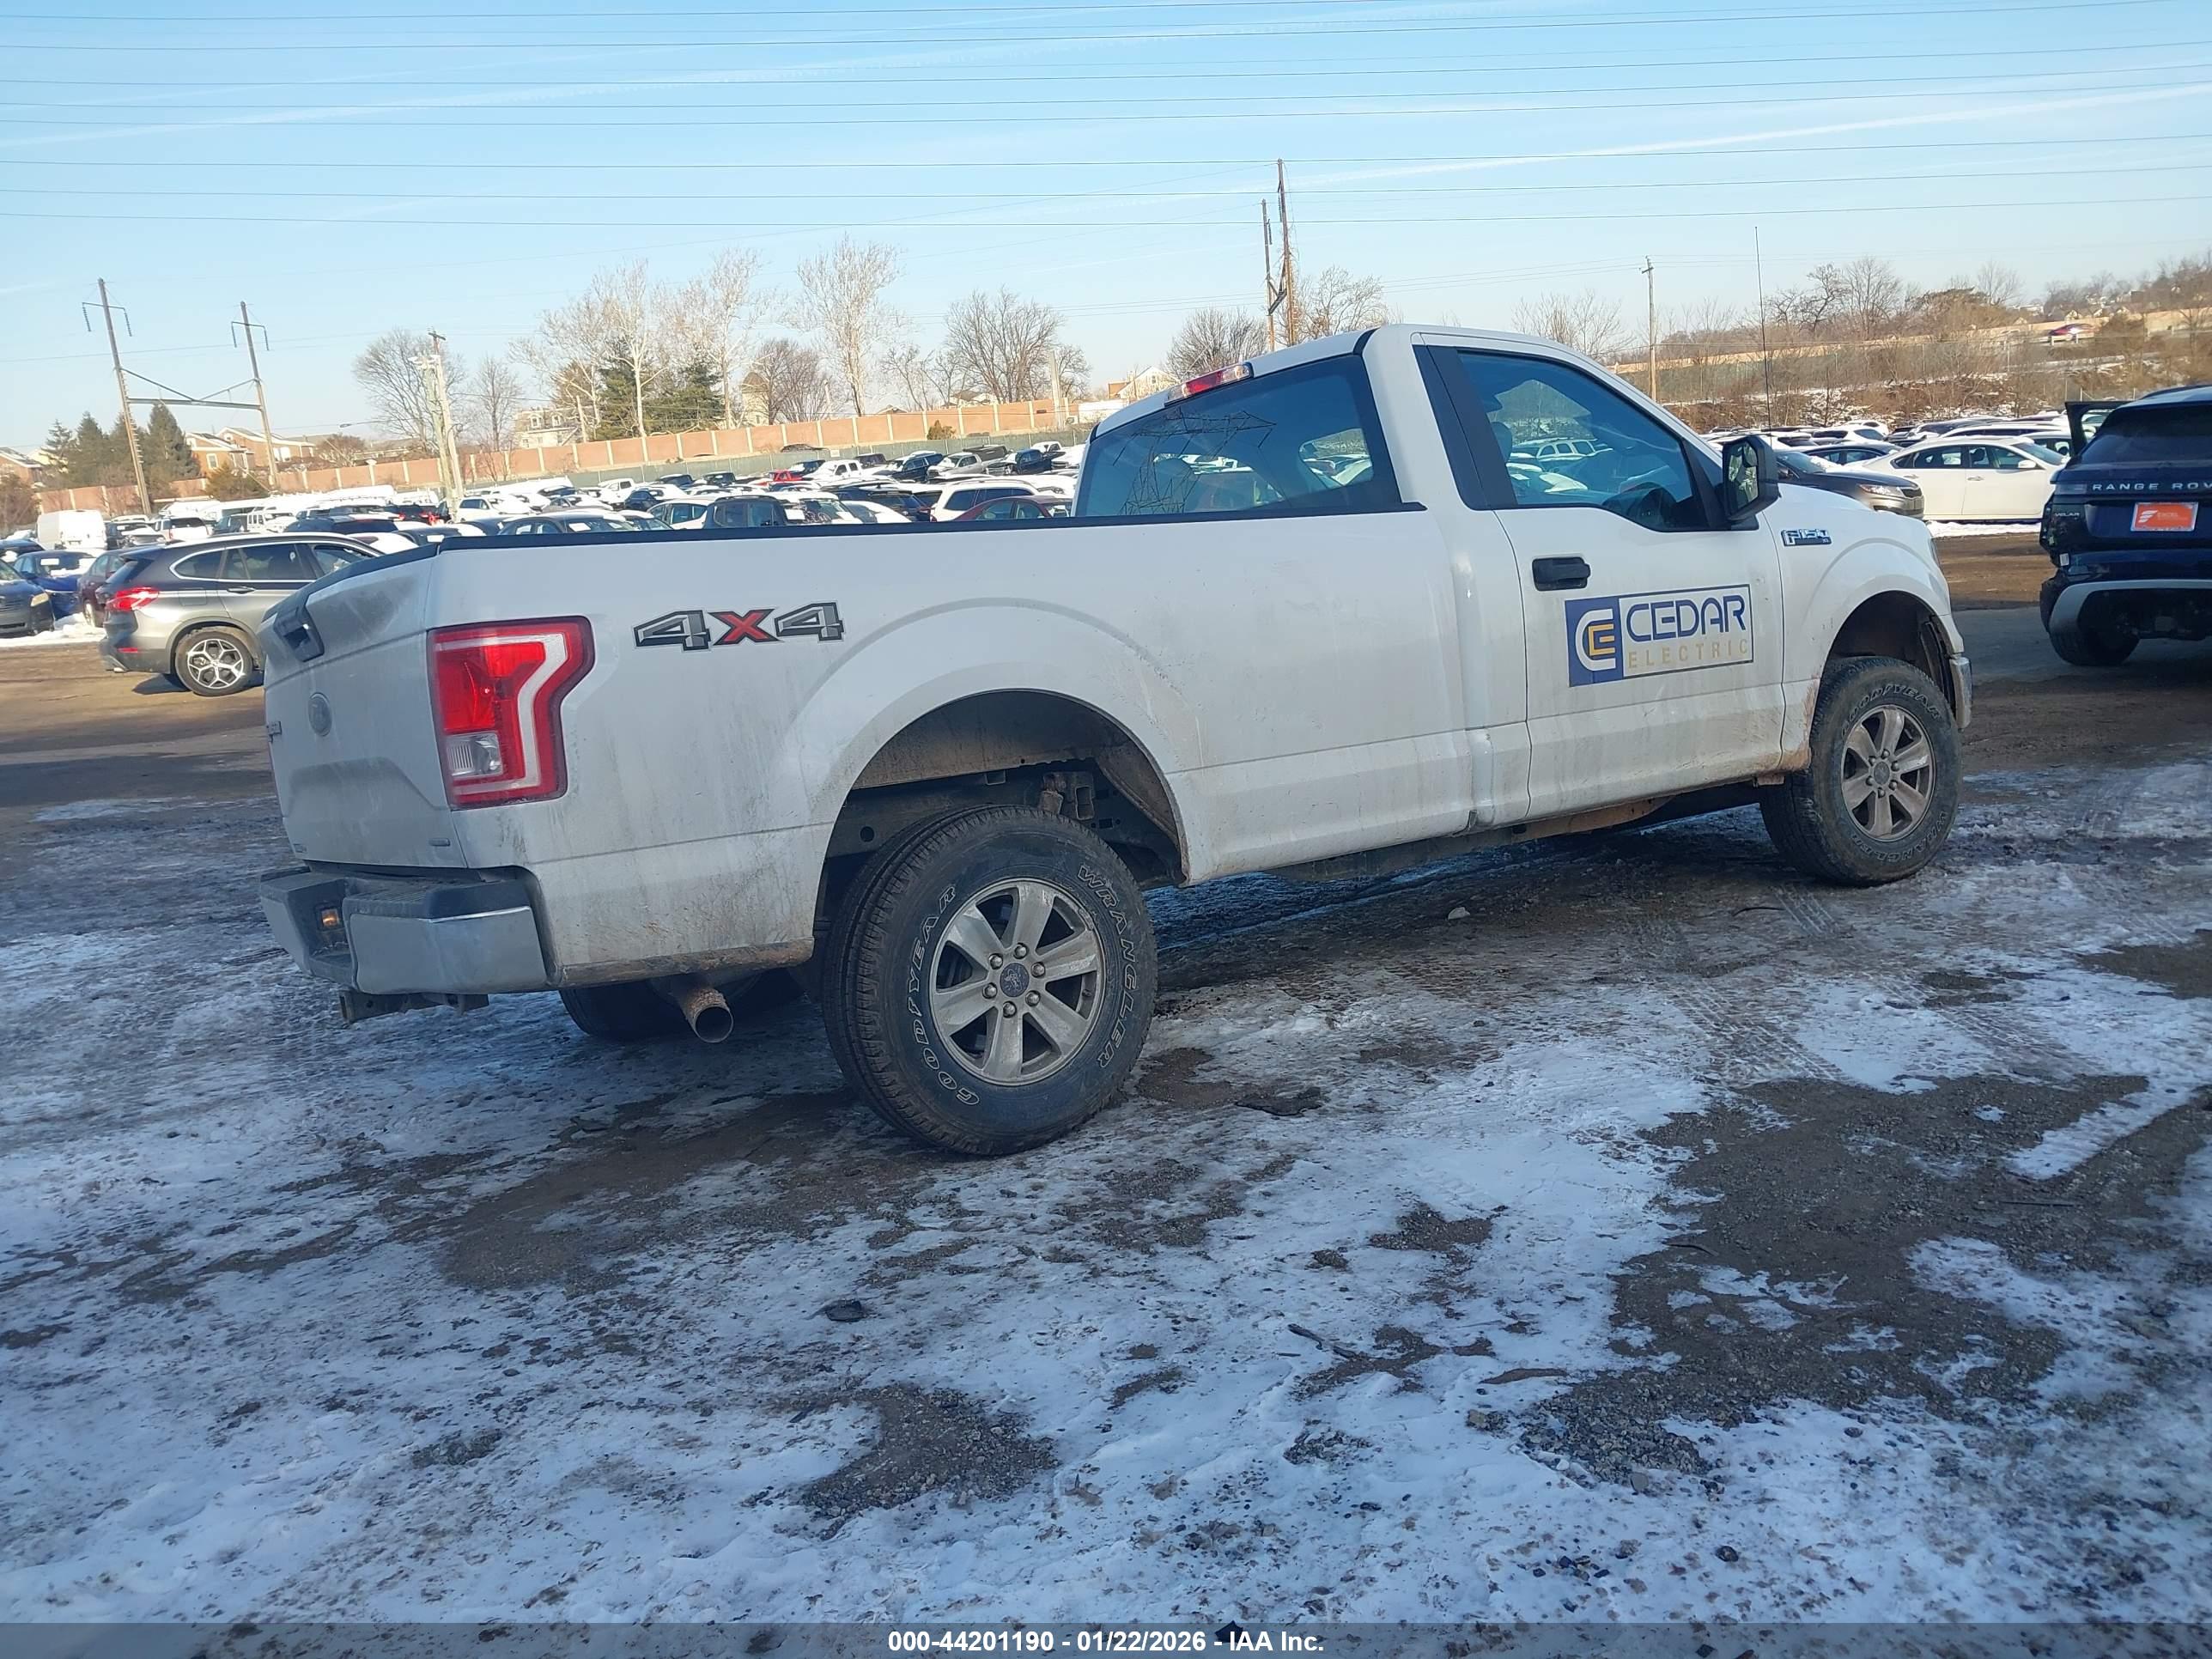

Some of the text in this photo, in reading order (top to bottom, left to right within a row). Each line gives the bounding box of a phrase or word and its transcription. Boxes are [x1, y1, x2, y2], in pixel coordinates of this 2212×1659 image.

[1626, 594, 1747, 642] CEDAR
[1628, 638, 1748, 669] ELECTRIC
[908, 886, 980, 1105] GOODYEAR
[1078, 865, 1137, 1068] WRANGLER
